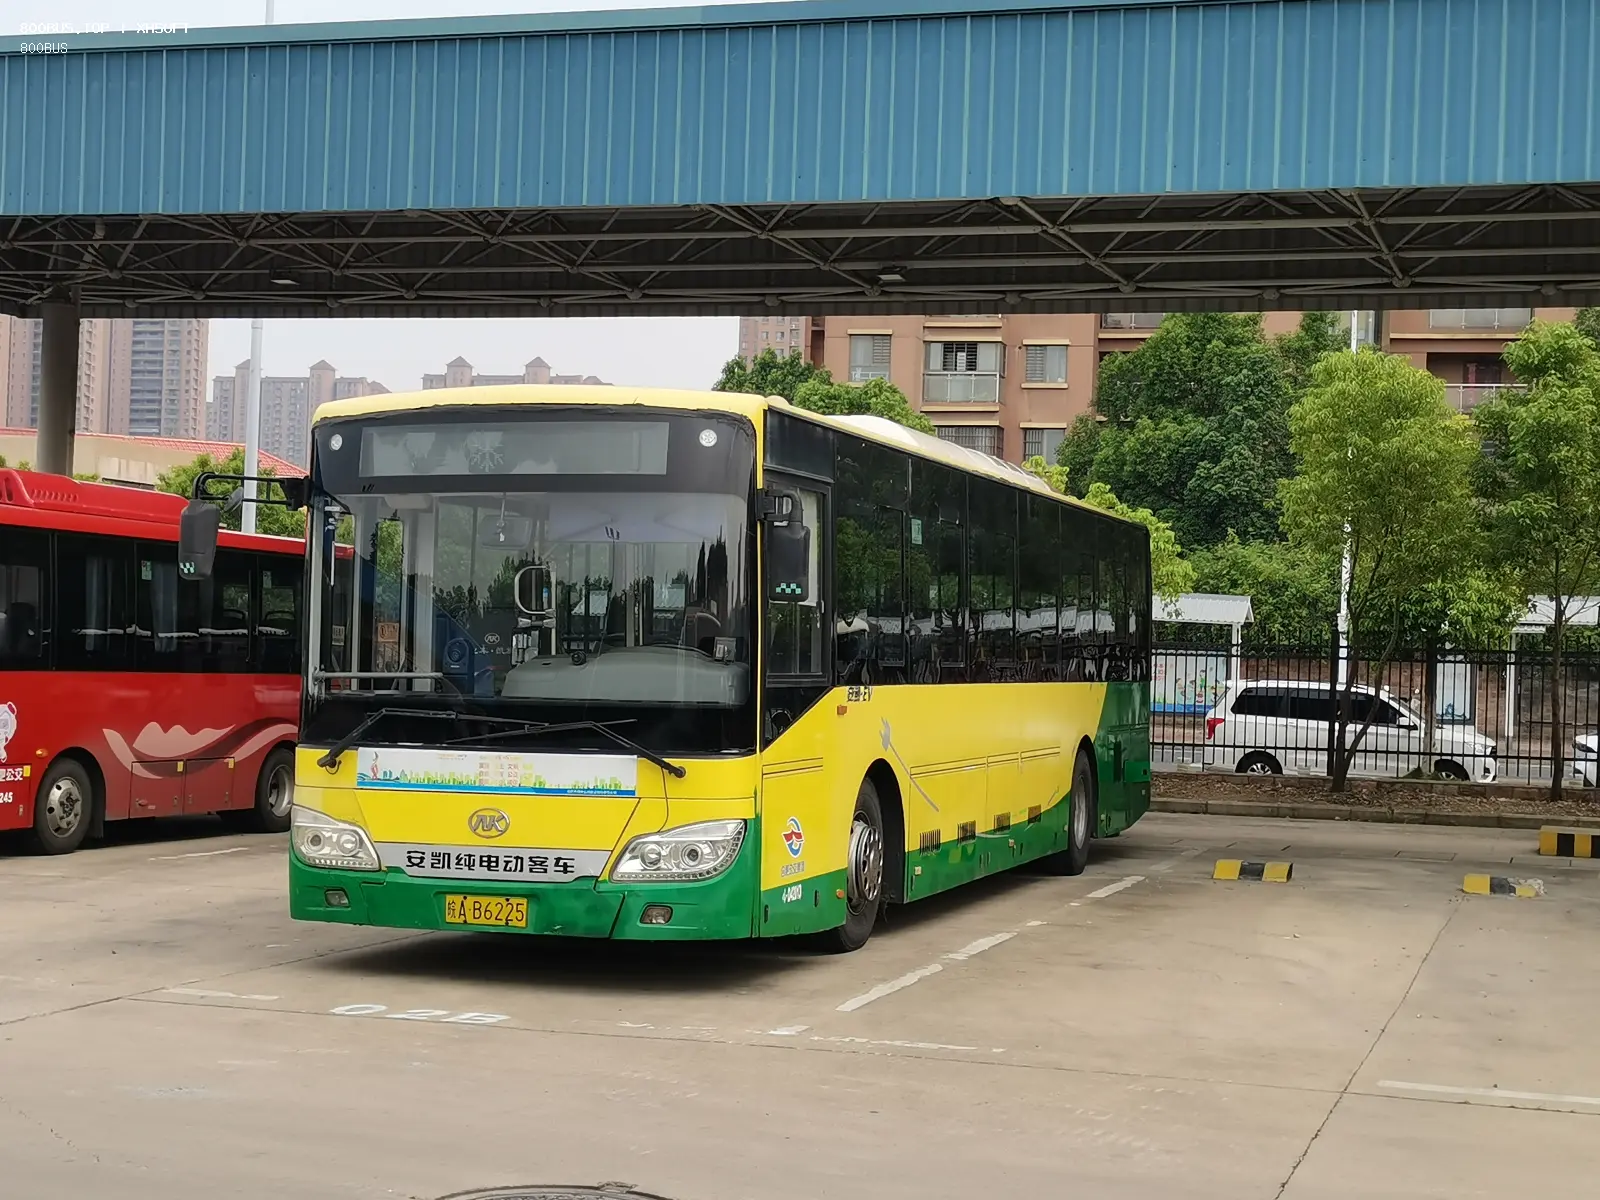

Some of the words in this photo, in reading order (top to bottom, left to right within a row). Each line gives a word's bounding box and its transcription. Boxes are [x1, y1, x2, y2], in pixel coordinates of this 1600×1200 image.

[405, 850, 576, 874] 安凯纯电动客车
